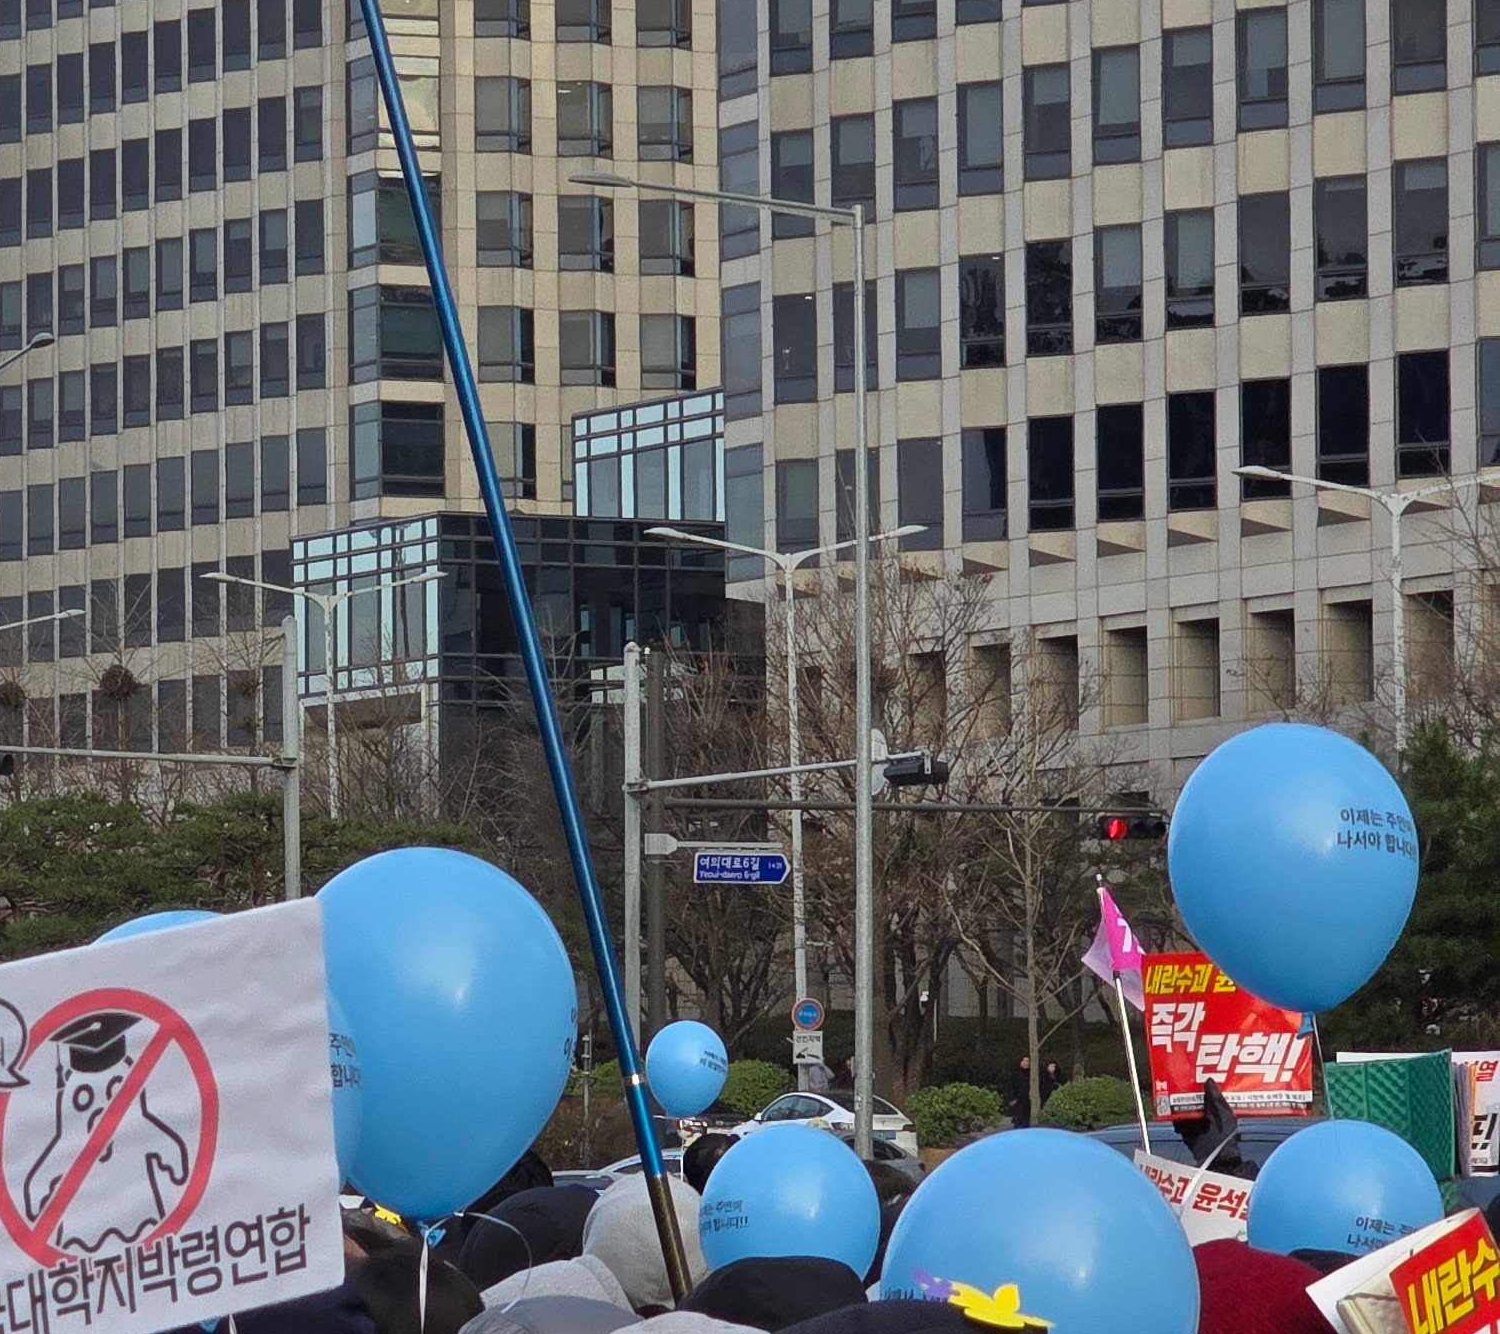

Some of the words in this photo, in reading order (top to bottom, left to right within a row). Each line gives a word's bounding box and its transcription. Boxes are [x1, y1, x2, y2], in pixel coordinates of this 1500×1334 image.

[1337, 830, 1382, 851] 나서야
[699, 857, 761, 871] 여의대로6길
[1145, 963, 1213, 995] 내란수괴
[1151, 1001, 1206, 1053] 즉각
[1195, 1031, 1308, 1084] 탄핵!
[1192, 1182, 1250, 1221] 윤석
